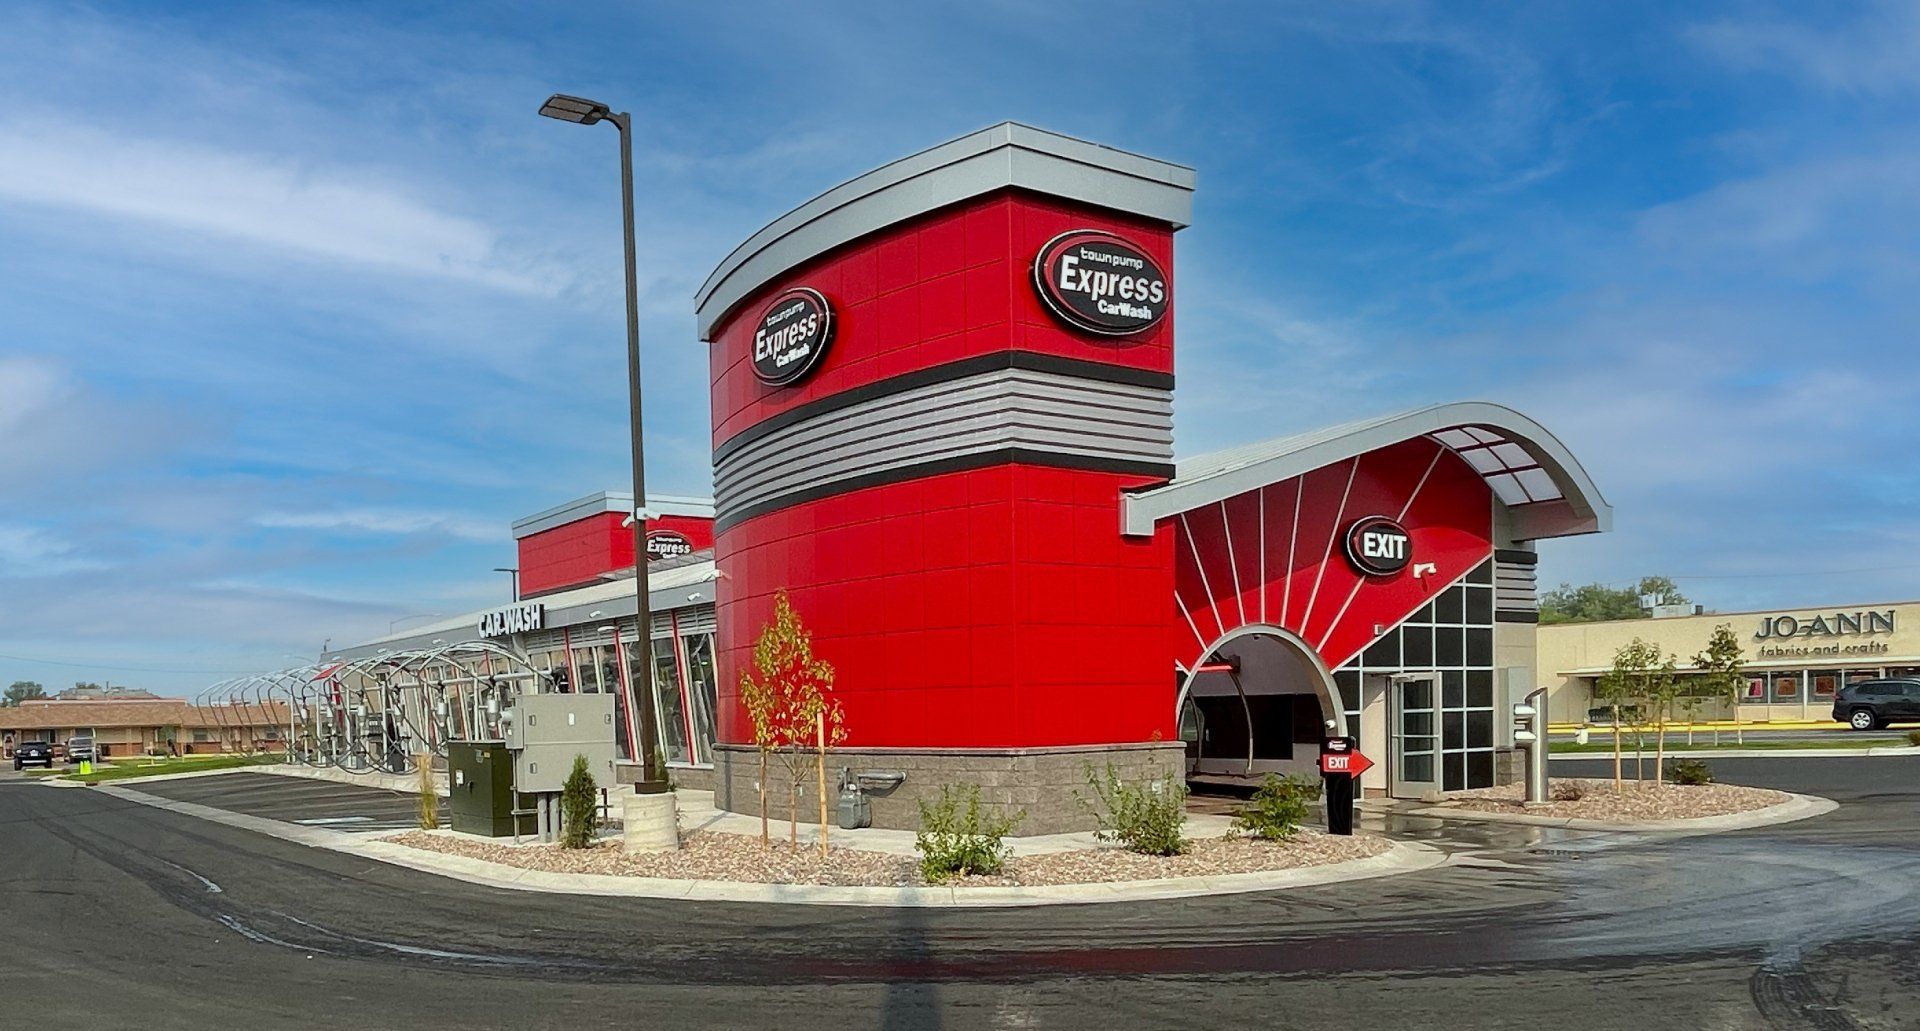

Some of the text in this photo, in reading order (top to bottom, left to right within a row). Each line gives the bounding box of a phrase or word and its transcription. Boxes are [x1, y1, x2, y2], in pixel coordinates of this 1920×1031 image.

[1060, 254, 1164, 304] Express
[1097, 299, 1152, 320] CarWash
[755, 313, 817, 362] Express
[647, 539, 690, 555] Express
[1364, 532, 1407, 559] EXIT
[479, 604, 541, 639] CAR WASH
[1760, 640, 1889, 657] fabrics and crafts
[1328, 756, 1350, 769] EXIT
